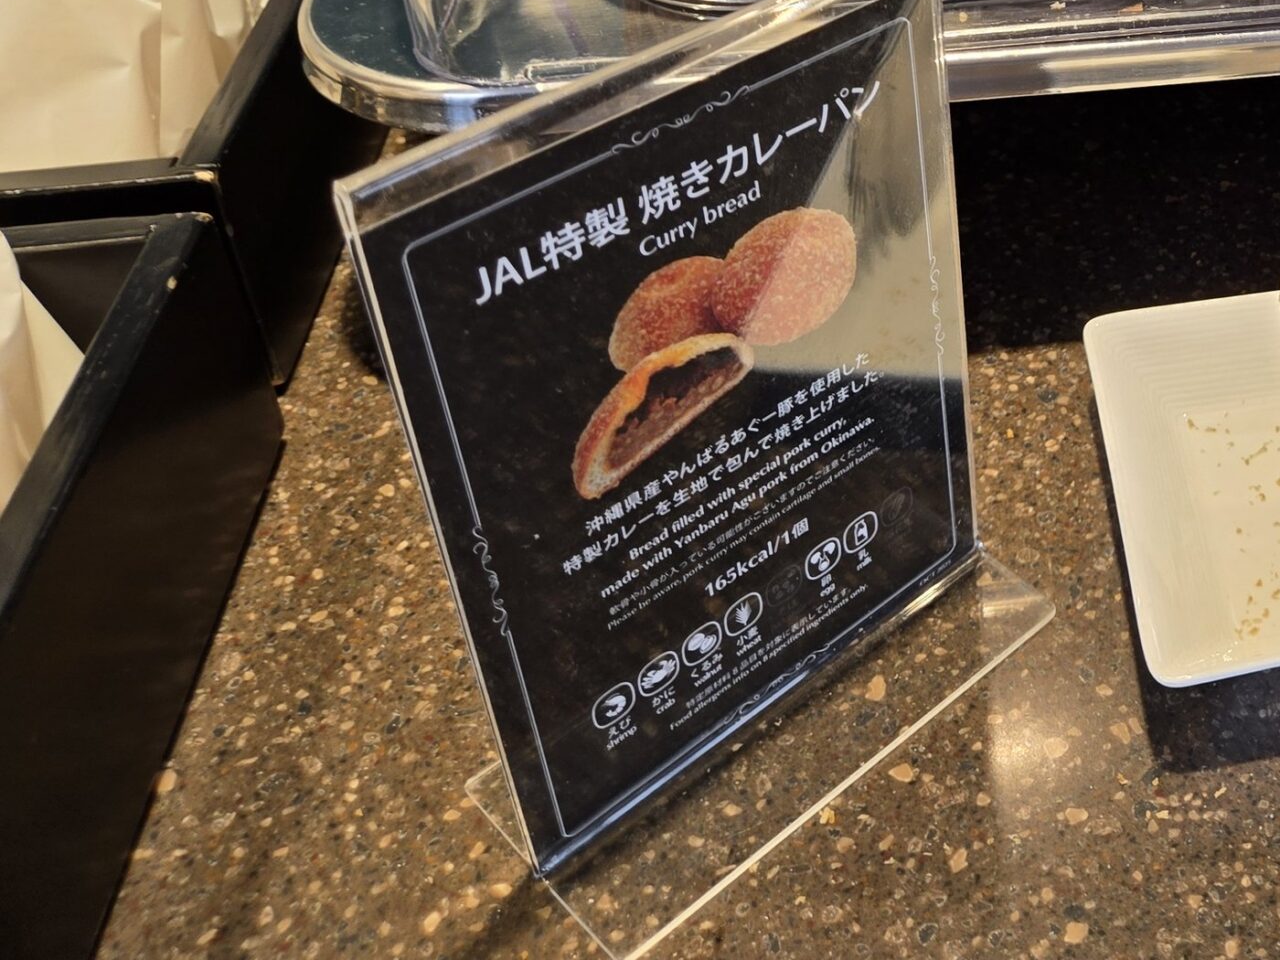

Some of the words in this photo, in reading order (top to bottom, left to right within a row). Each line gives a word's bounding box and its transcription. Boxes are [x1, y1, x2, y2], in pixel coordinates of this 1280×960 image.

[475, 196, 631, 306] JAL特製
[637, 80, 880, 226] 焼きカレーパン
[638, 214, 699, 257] Curry
[702, 180, 763, 225] bread
[584, 350, 870, 537] 沖縄県産やんばるあぐー豚を使用した
[601, 568, 640, 599] made
[642, 547, 673, 571] with
[673, 511, 729, 549] Yanbaru
[731, 492, 756, 514] Agu
[758, 470, 788, 498] pork
[790, 451, 819, 475] from
[820, 416, 875, 454] Okinawa.
[628, 527, 670, 561] Bread
[671, 503, 705, 533] filled
[707, 485, 737, 509] with
[738, 455, 781, 490] special
[783, 437, 812, 465] pork
[813, 416, 847, 442] curry,
[607, 607, 638, 631] Please
[682, 562, 704, 583] pork
[705, 546, 729, 565] curry
[729, 533, 748, 549] may
[749, 511, 781, 536] contain
[781, 489, 816, 514] cartilage
[817, 475, 833, 490] and
[833, 461, 854, 479] small
[704, 517, 810, 597] 165kcal/1個
[820, 582, 836, 597] egg
[669, 710, 693, 730] Food
[693, 683, 731, 714] allergens
[732, 669, 750, 685] info
[750, 660, 762, 672] on
[768, 626, 806, 660] specified
[805, 597, 849, 632] ingredients
[691, 652, 723, 678] くるみ
[736, 634, 762, 657] wheat
[652, 686, 675, 708] かに
[694, 663, 722, 687] walnut
[608, 715, 631, 739] えび
[656, 698, 676, 714] crab
[606, 725, 637, 750] shrimp
